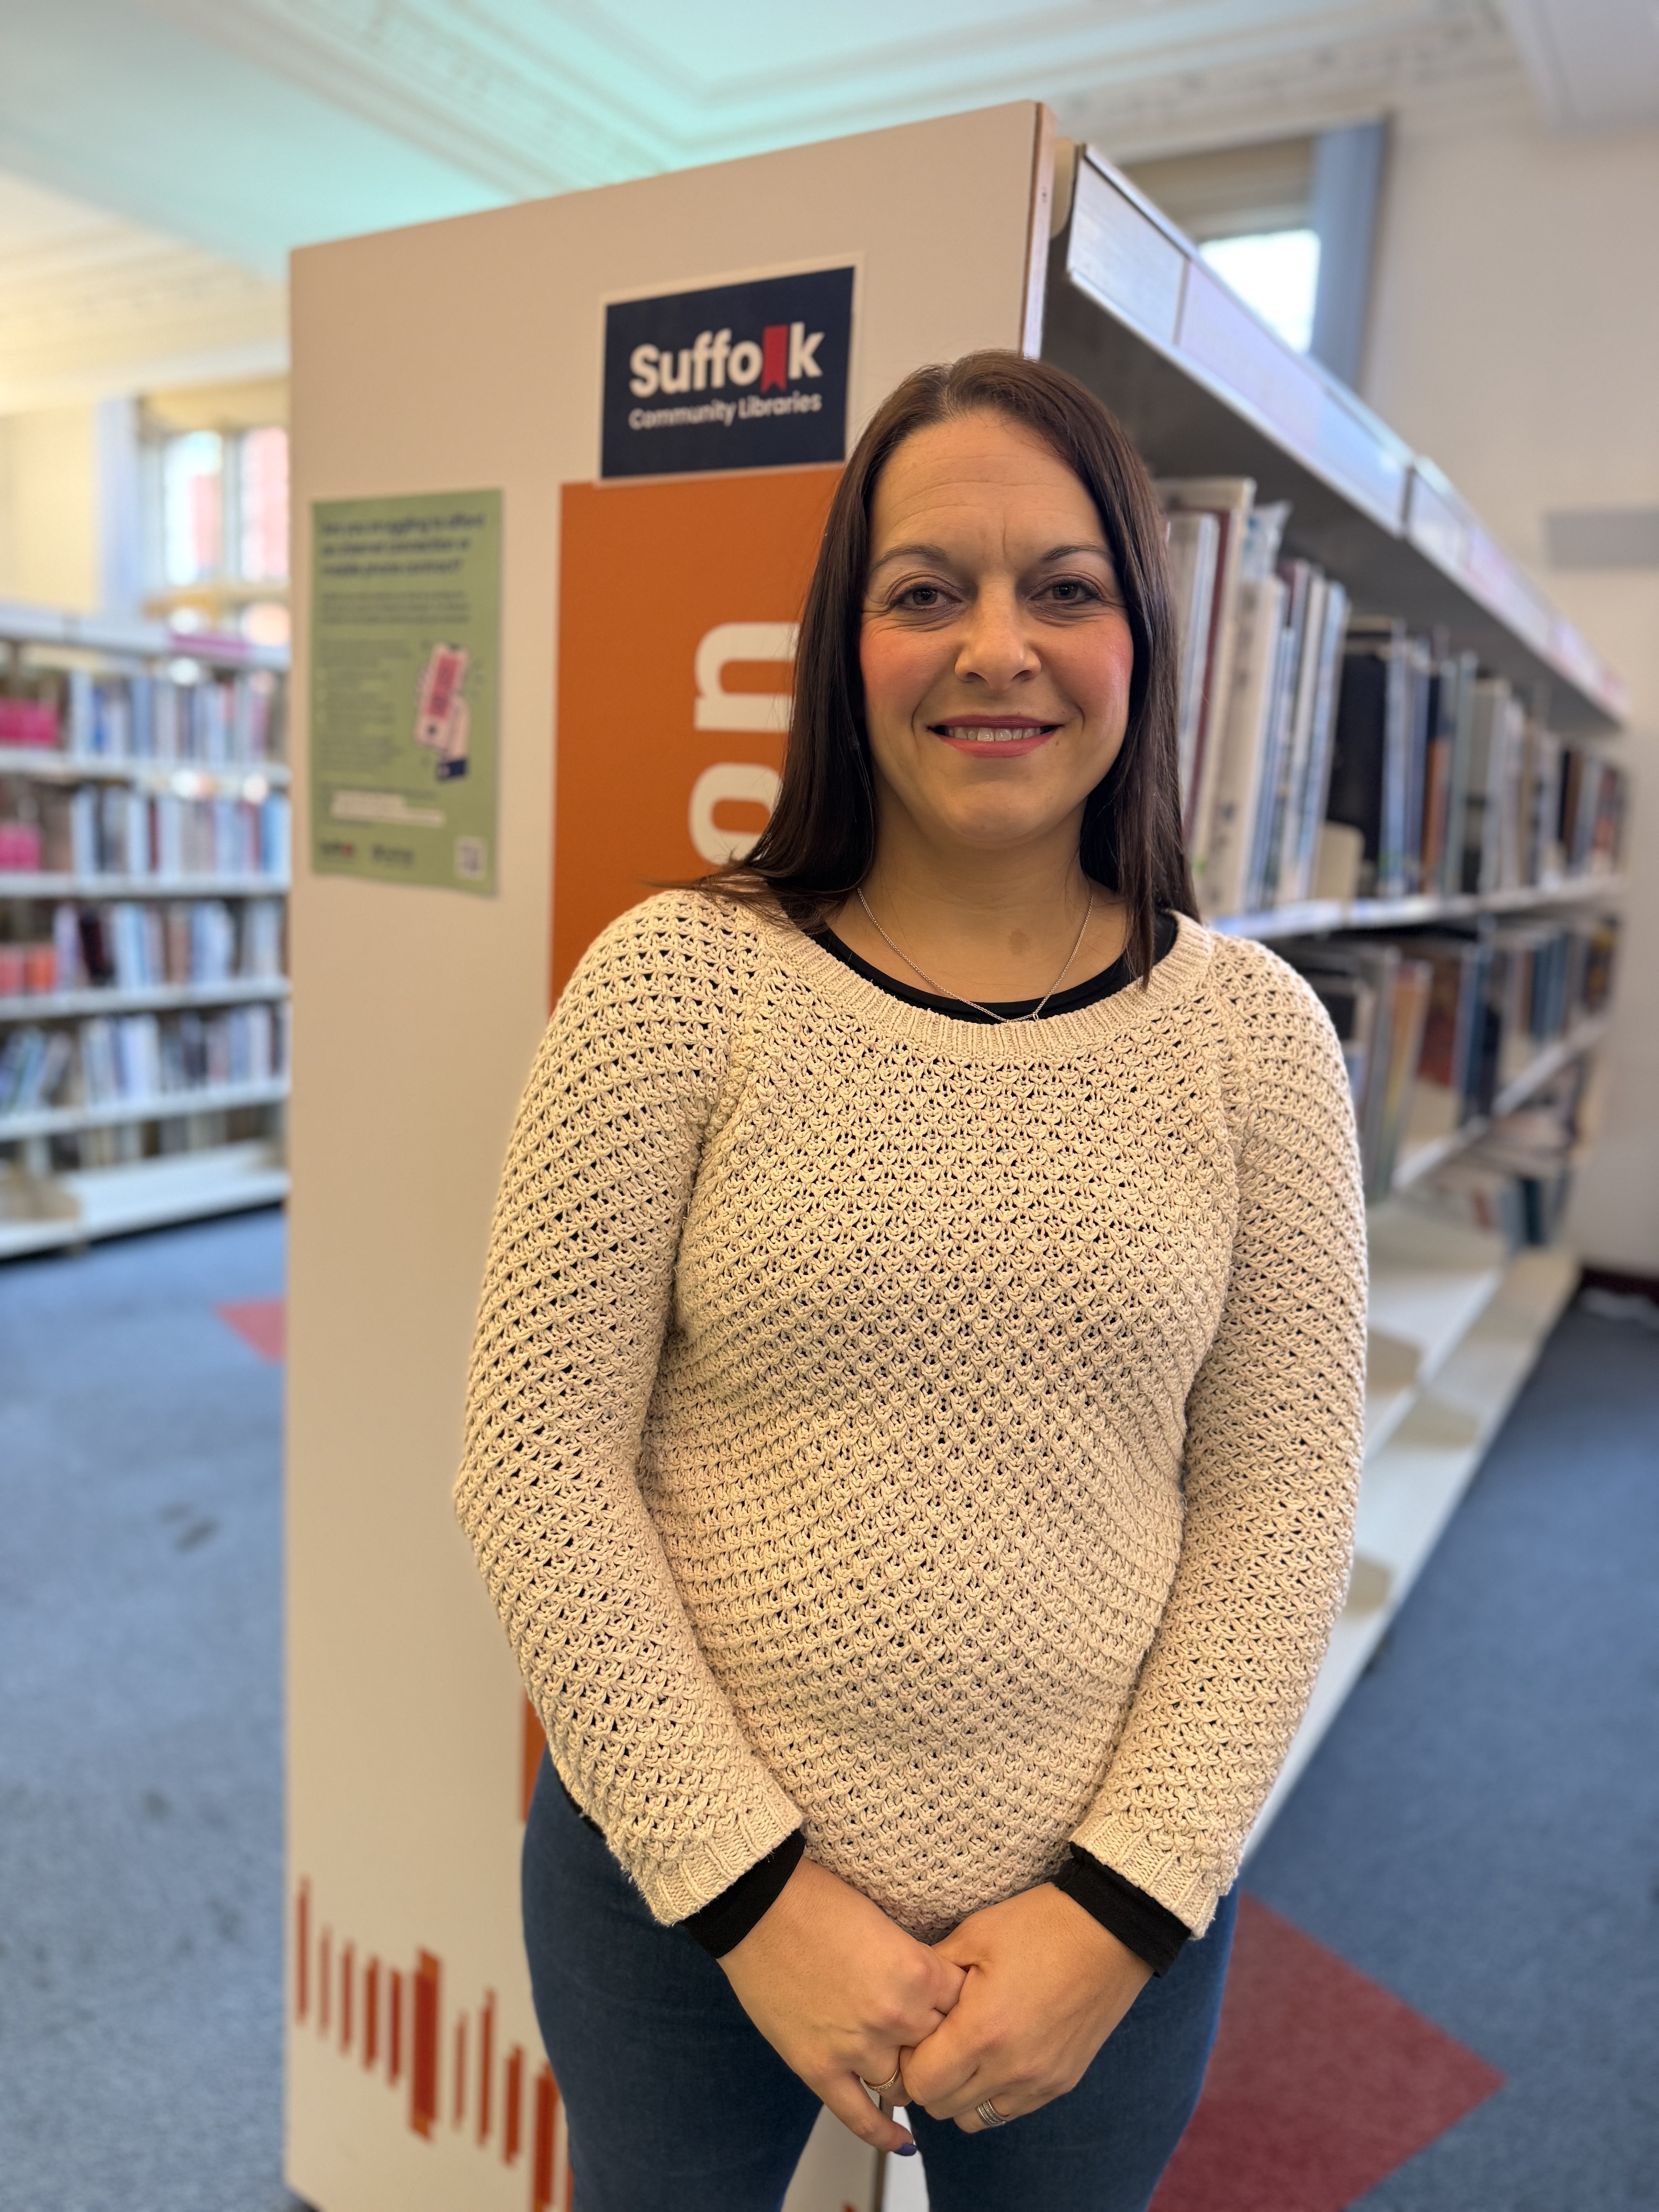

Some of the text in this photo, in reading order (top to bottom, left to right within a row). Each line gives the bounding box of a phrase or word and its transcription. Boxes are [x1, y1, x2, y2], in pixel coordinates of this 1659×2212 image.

[629, 321, 825, 398] Suffolk
[628, 390, 823, 430] Community Libraries
[446, 513, 485, 529] afford
